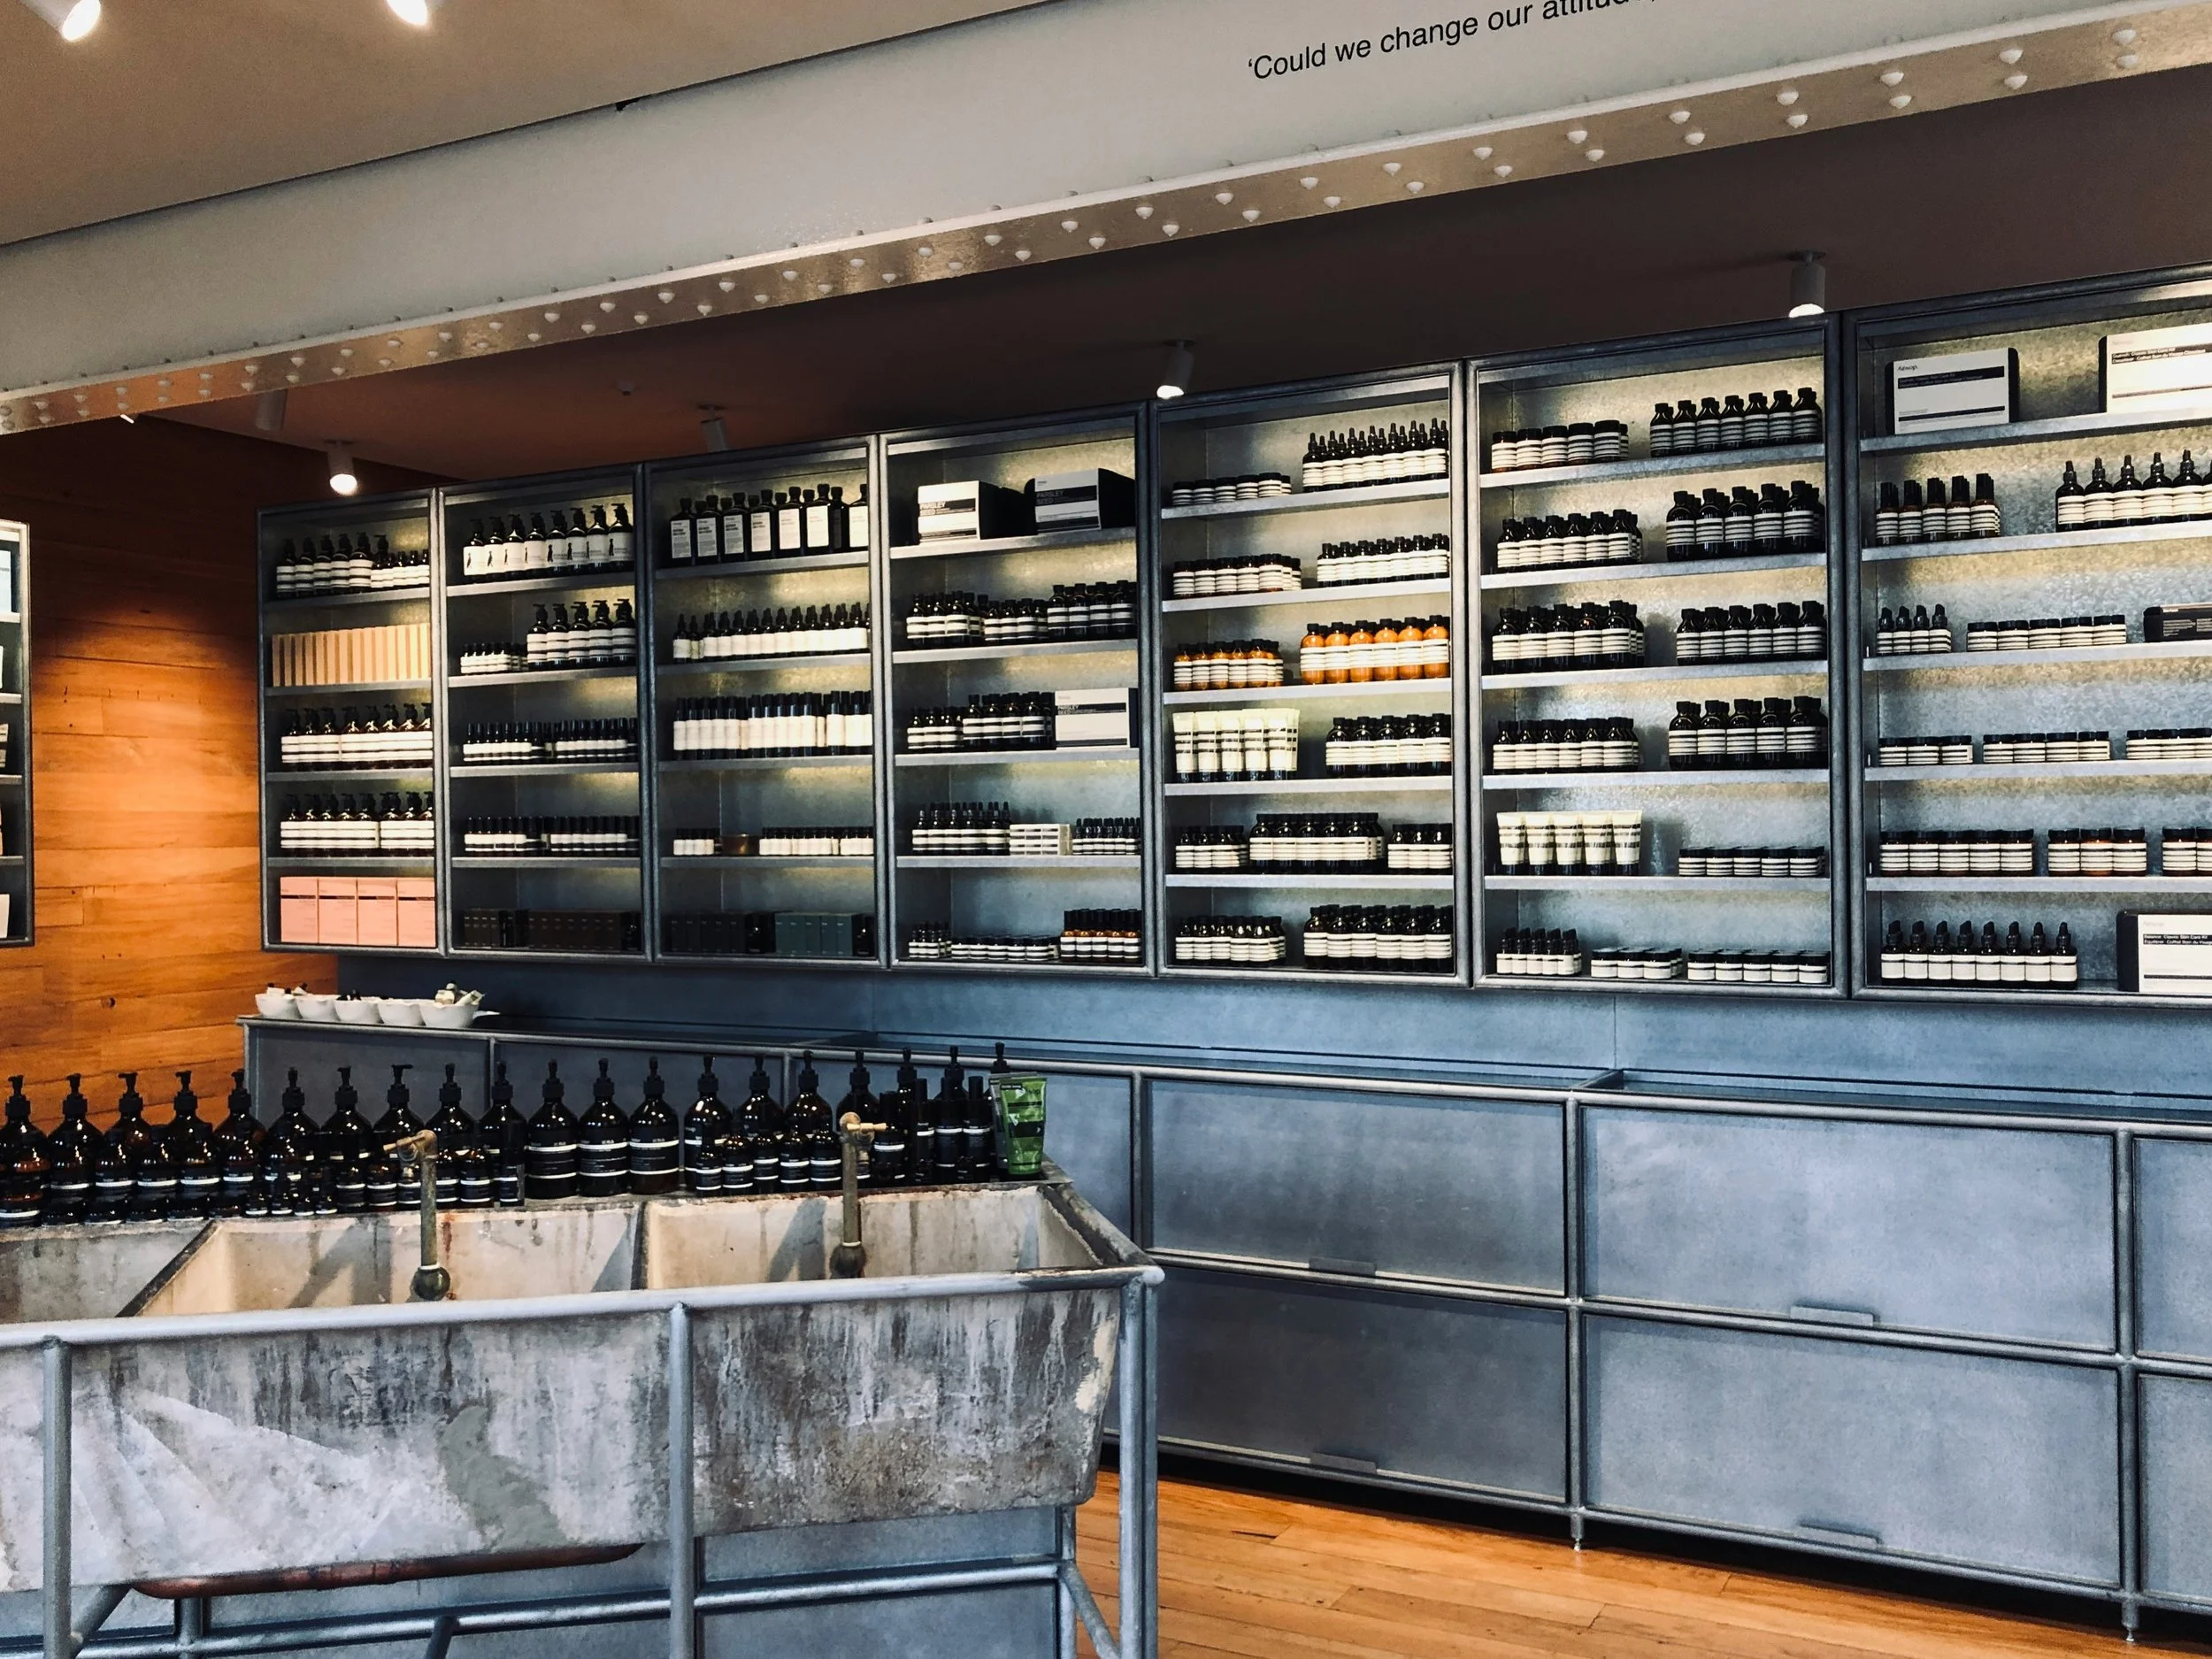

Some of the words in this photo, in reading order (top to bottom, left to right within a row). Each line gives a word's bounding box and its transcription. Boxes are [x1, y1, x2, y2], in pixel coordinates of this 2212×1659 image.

[1335, 39, 1371, 63] we
[1380, 17, 1479, 53] change
[1487, 4, 1533, 31] our
